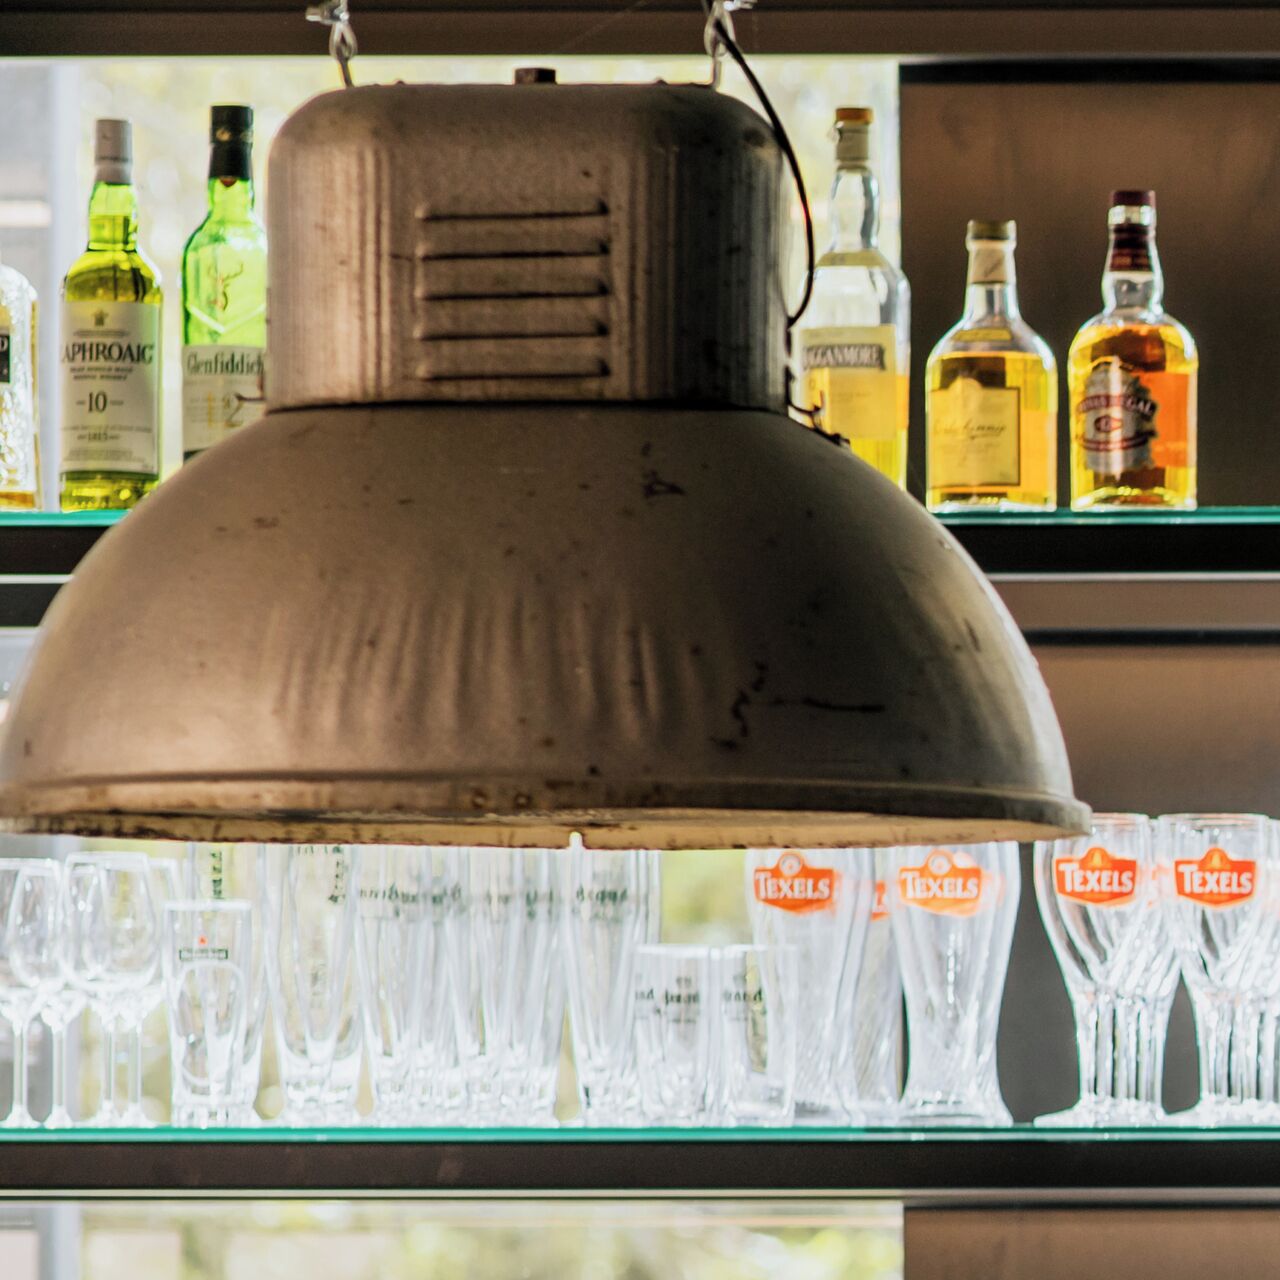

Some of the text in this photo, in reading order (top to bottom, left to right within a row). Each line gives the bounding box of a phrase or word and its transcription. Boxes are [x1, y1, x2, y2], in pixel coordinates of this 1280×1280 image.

[87, 391, 107, 413] 10
[755, 872, 830, 900] TEXELS
[901, 871, 980, 900] TEXELS
[1058, 862, 1134, 893] TEXELS
[1177, 863, 1252, 895] TEXELS
